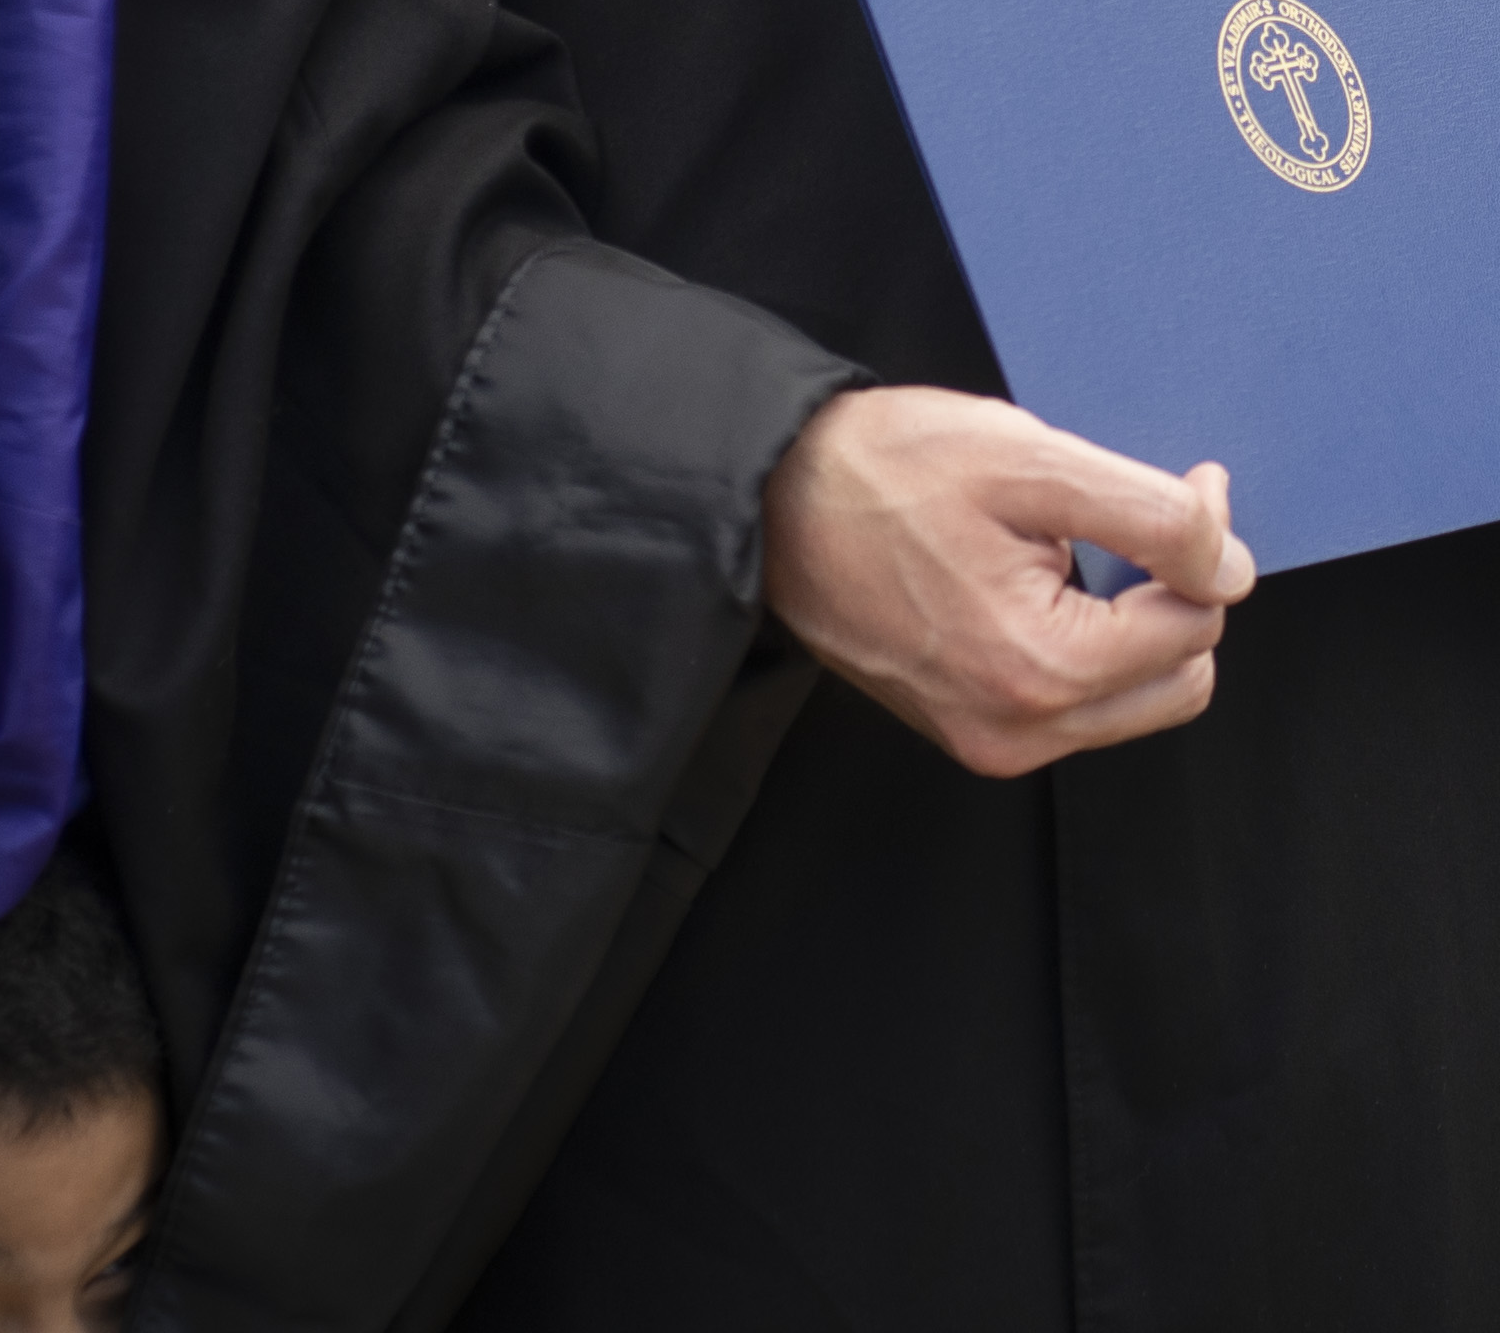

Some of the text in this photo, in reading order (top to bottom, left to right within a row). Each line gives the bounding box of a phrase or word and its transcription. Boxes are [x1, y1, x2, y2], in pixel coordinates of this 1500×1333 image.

[1223, 0, 1273, 68] VLADIMIR'S
[1279, 2, 1353, 79] ORTHODOX
[1239, 86, 1366, 185] THEOLOGICAL SEMINARY
